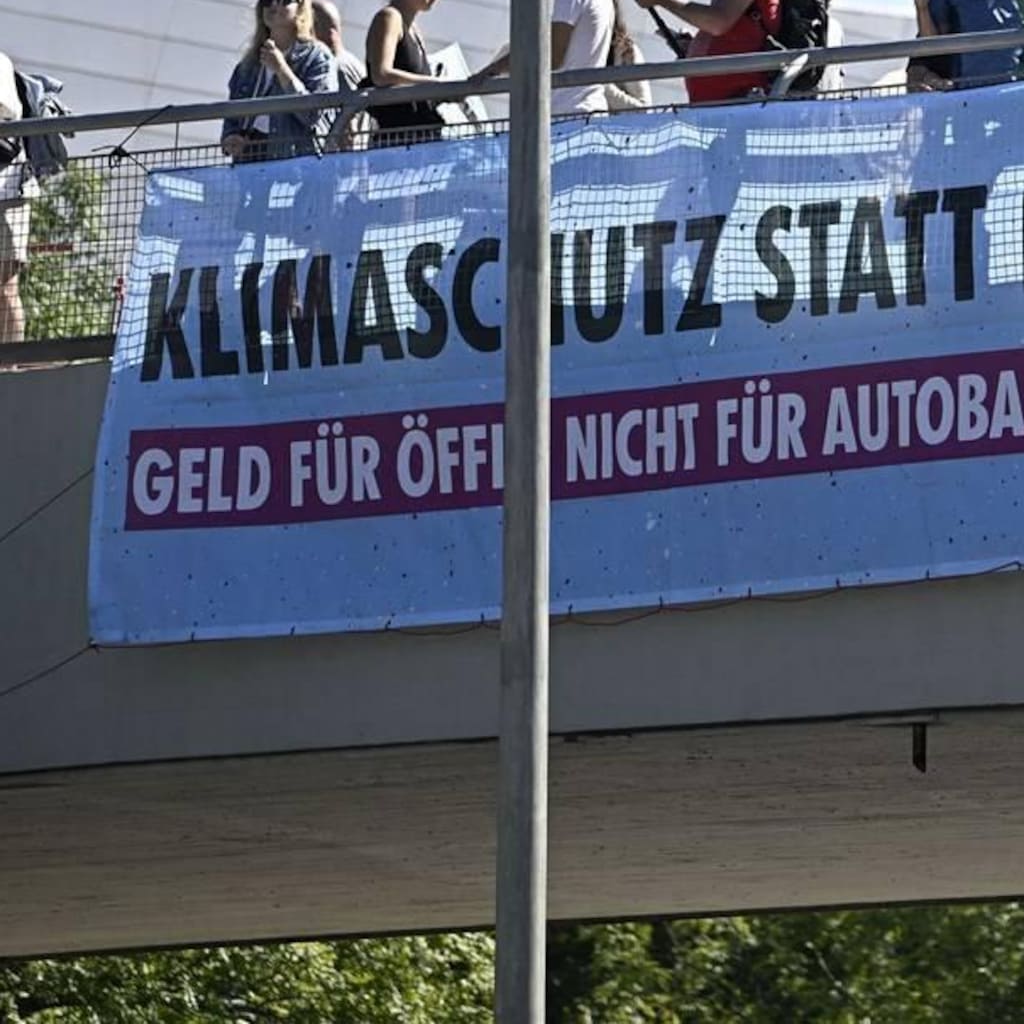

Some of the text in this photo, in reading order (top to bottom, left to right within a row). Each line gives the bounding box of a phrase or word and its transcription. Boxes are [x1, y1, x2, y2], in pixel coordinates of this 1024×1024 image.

[754, 185, 988, 324] STATT
[132, 444, 271, 516] GELD
[290, 422, 381, 507] FÜR
[566, 400, 700, 483] NICHT
[716, 378, 807, 466] FÜR
